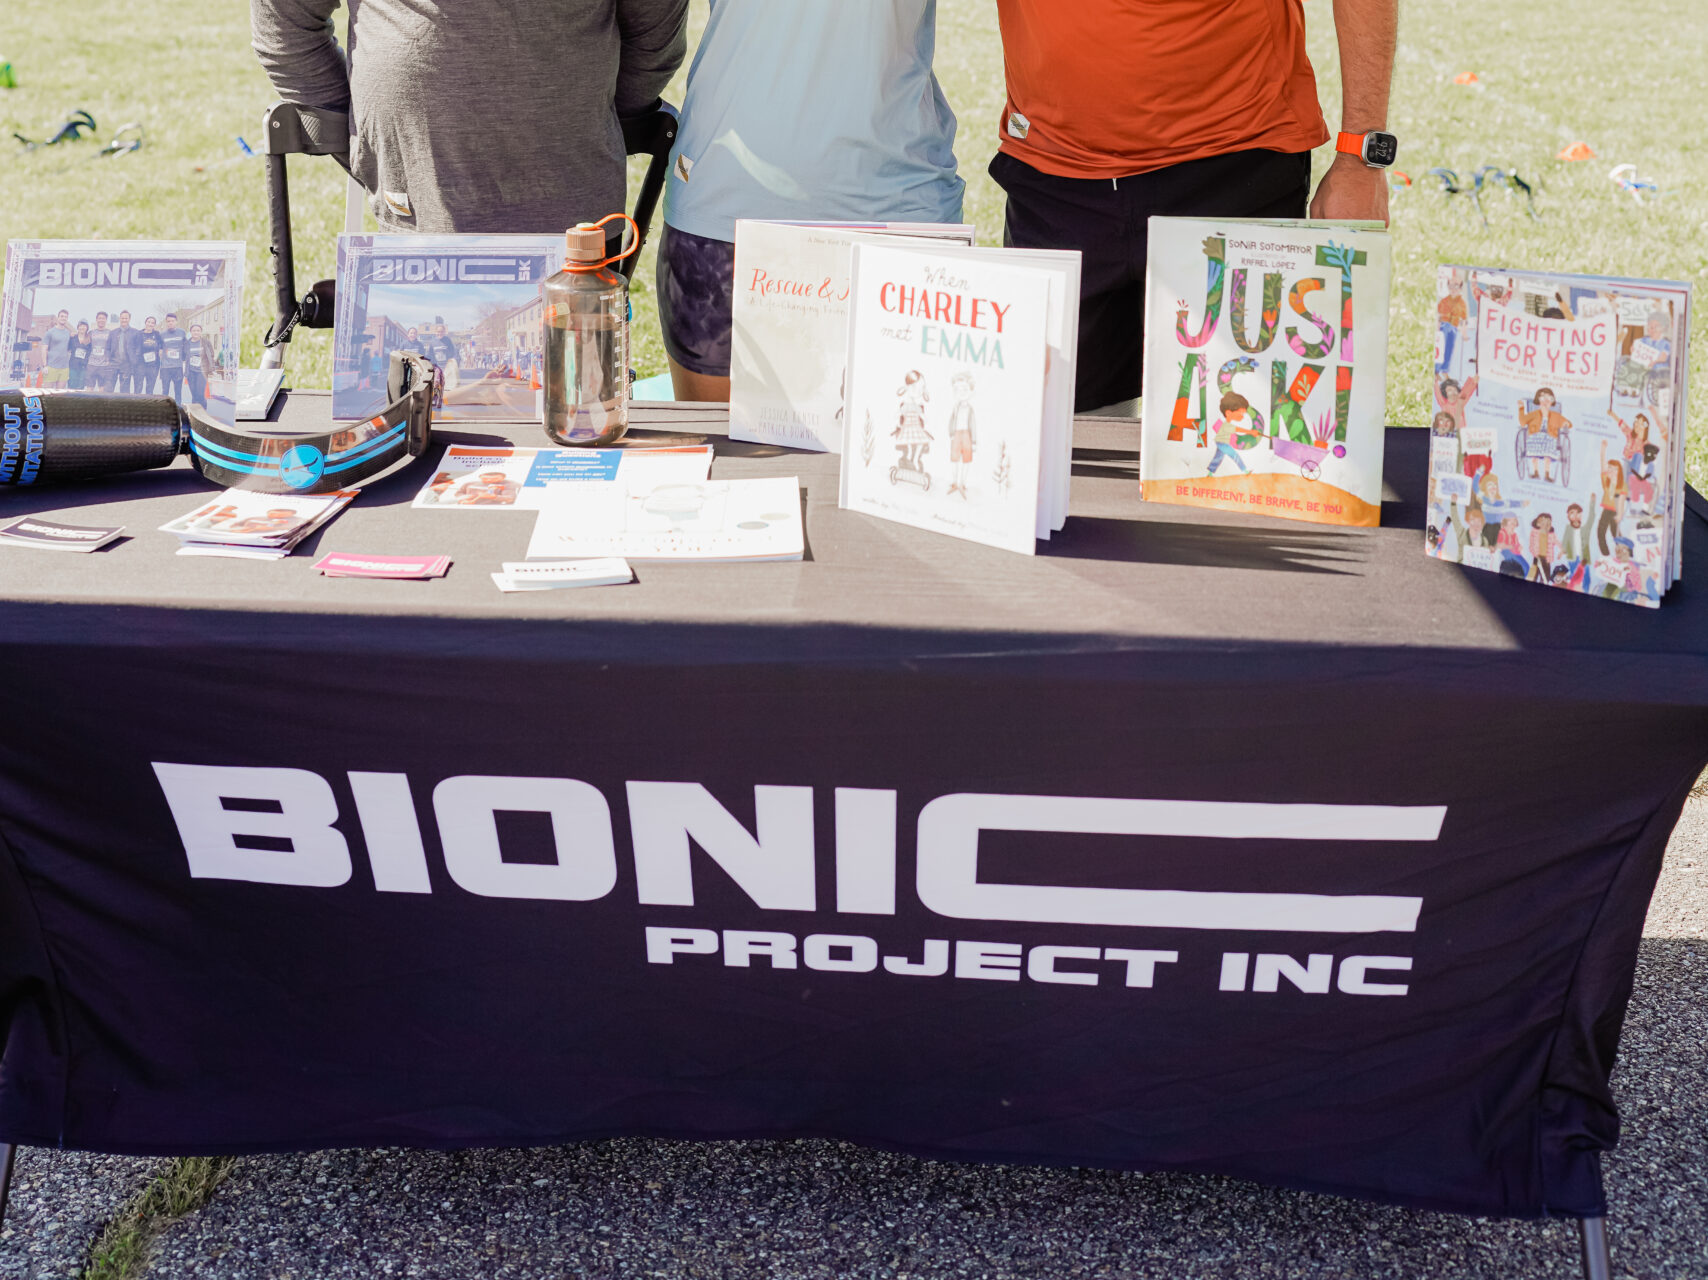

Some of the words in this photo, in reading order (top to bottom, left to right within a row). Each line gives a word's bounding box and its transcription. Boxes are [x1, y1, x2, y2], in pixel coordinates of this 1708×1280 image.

[1259, 242, 1313, 255] SOTOMAYOR
[39, 261, 194, 286] BIONIC
[194, 263, 210, 286] 5K
[372, 258, 516, 281] BIONIC
[518, 259, 531, 281] 5K
[748, 268, 814, 297] Rescue
[817, 276, 834, 303] &
[924, 265, 970, 291] When
[880, 282, 1011, 333] CHARLEY
[1175, 235, 1367, 363] JUST
[1486, 309, 1606, 347] FIGHTING
[921, 325, 1004, 369] EMMA
[1494, 339, 1537, 369] FOR
[1547, 348, 1599, 376] YES!
[1167, 353, 1355, 458] ASK!
[1176, 485, 1189, 496] BE
[1192, 487, 1246, 504] DIFFERENT,
[1249, 495, 1262, 505] BE
[1266, 496, 1303, 512] BRAVE,
[1307, 501, 1320, 512] BE
[1323, 504, 1342, 514] YOU
[150, 761, 1448, 932] BIONIC
[645, 927, 1178, 989] PROJECT
[1218, 952, 1413, 996] INC
